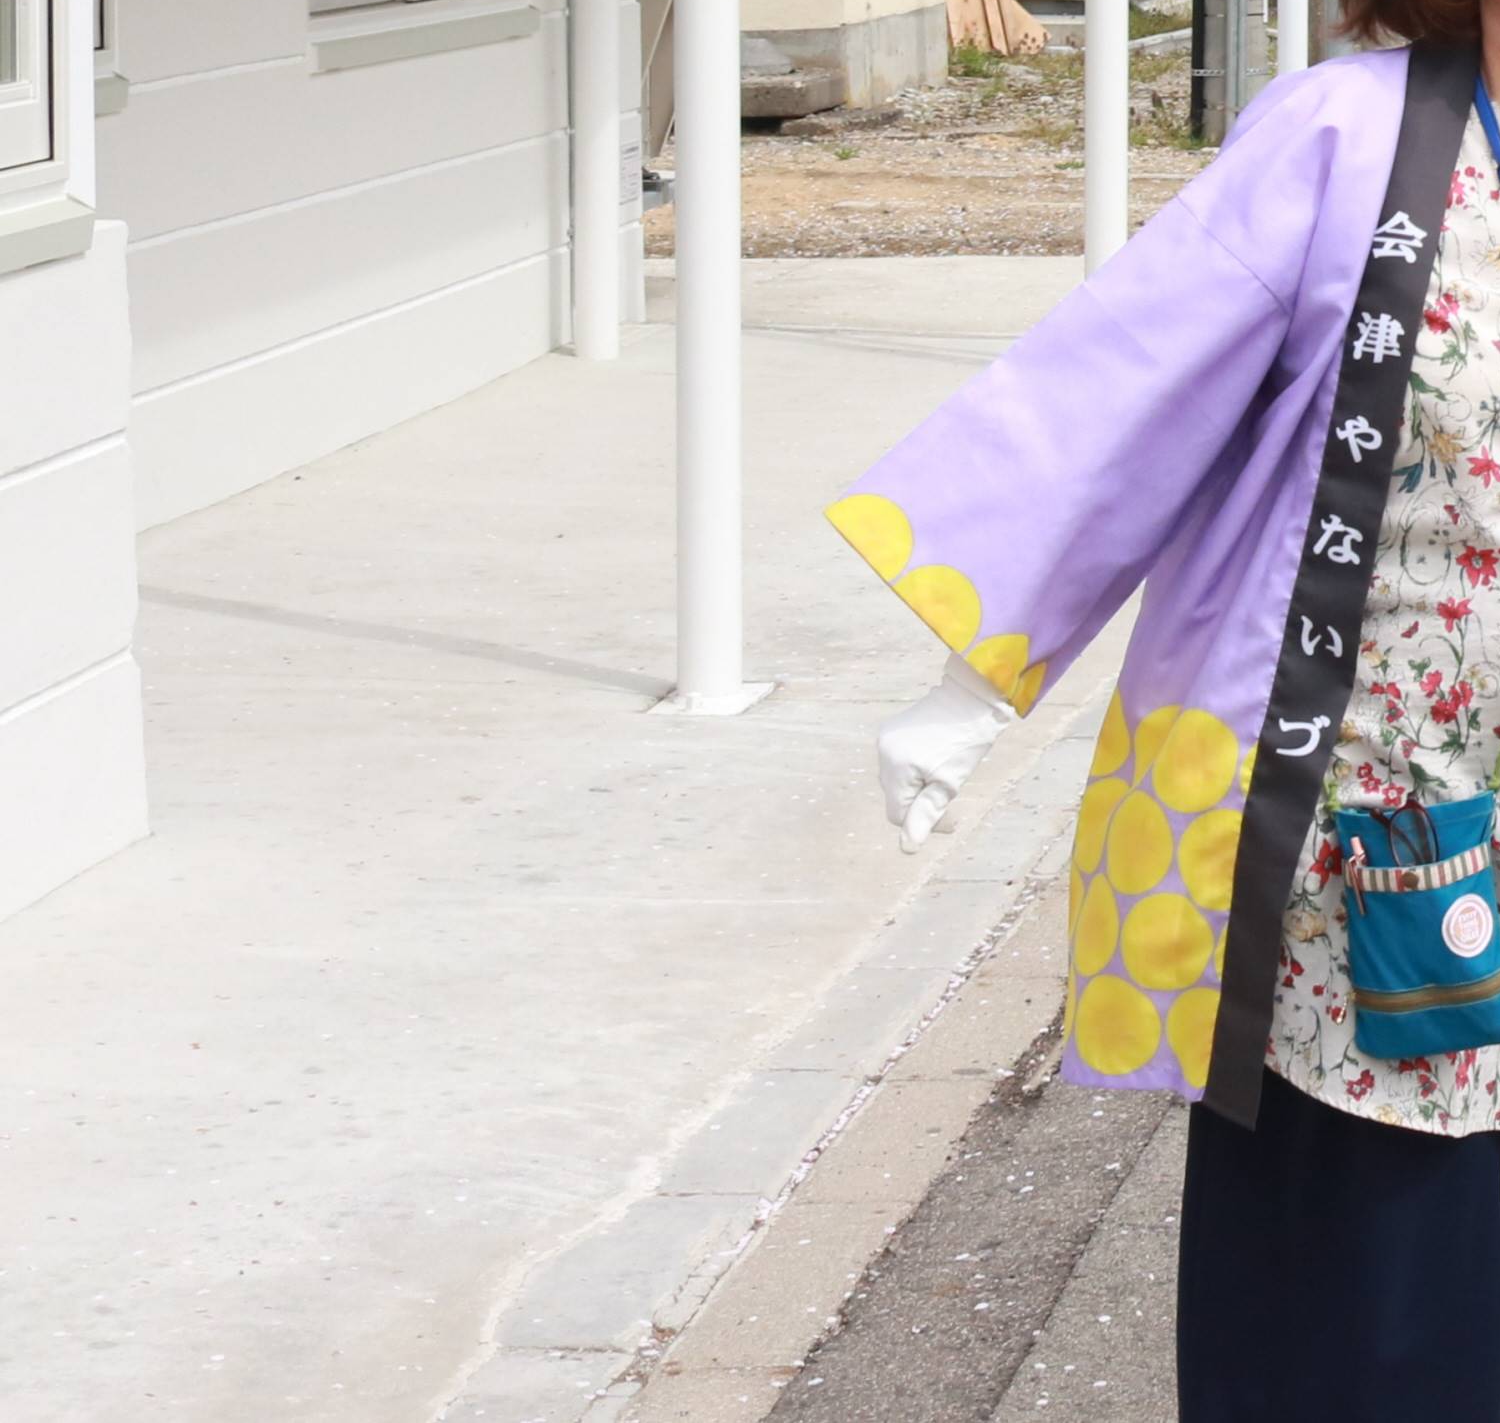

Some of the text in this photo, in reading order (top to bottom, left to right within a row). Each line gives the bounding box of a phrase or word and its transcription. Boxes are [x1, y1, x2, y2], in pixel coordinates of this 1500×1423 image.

[1275, 211, 1428, 757] 会津やないづ
